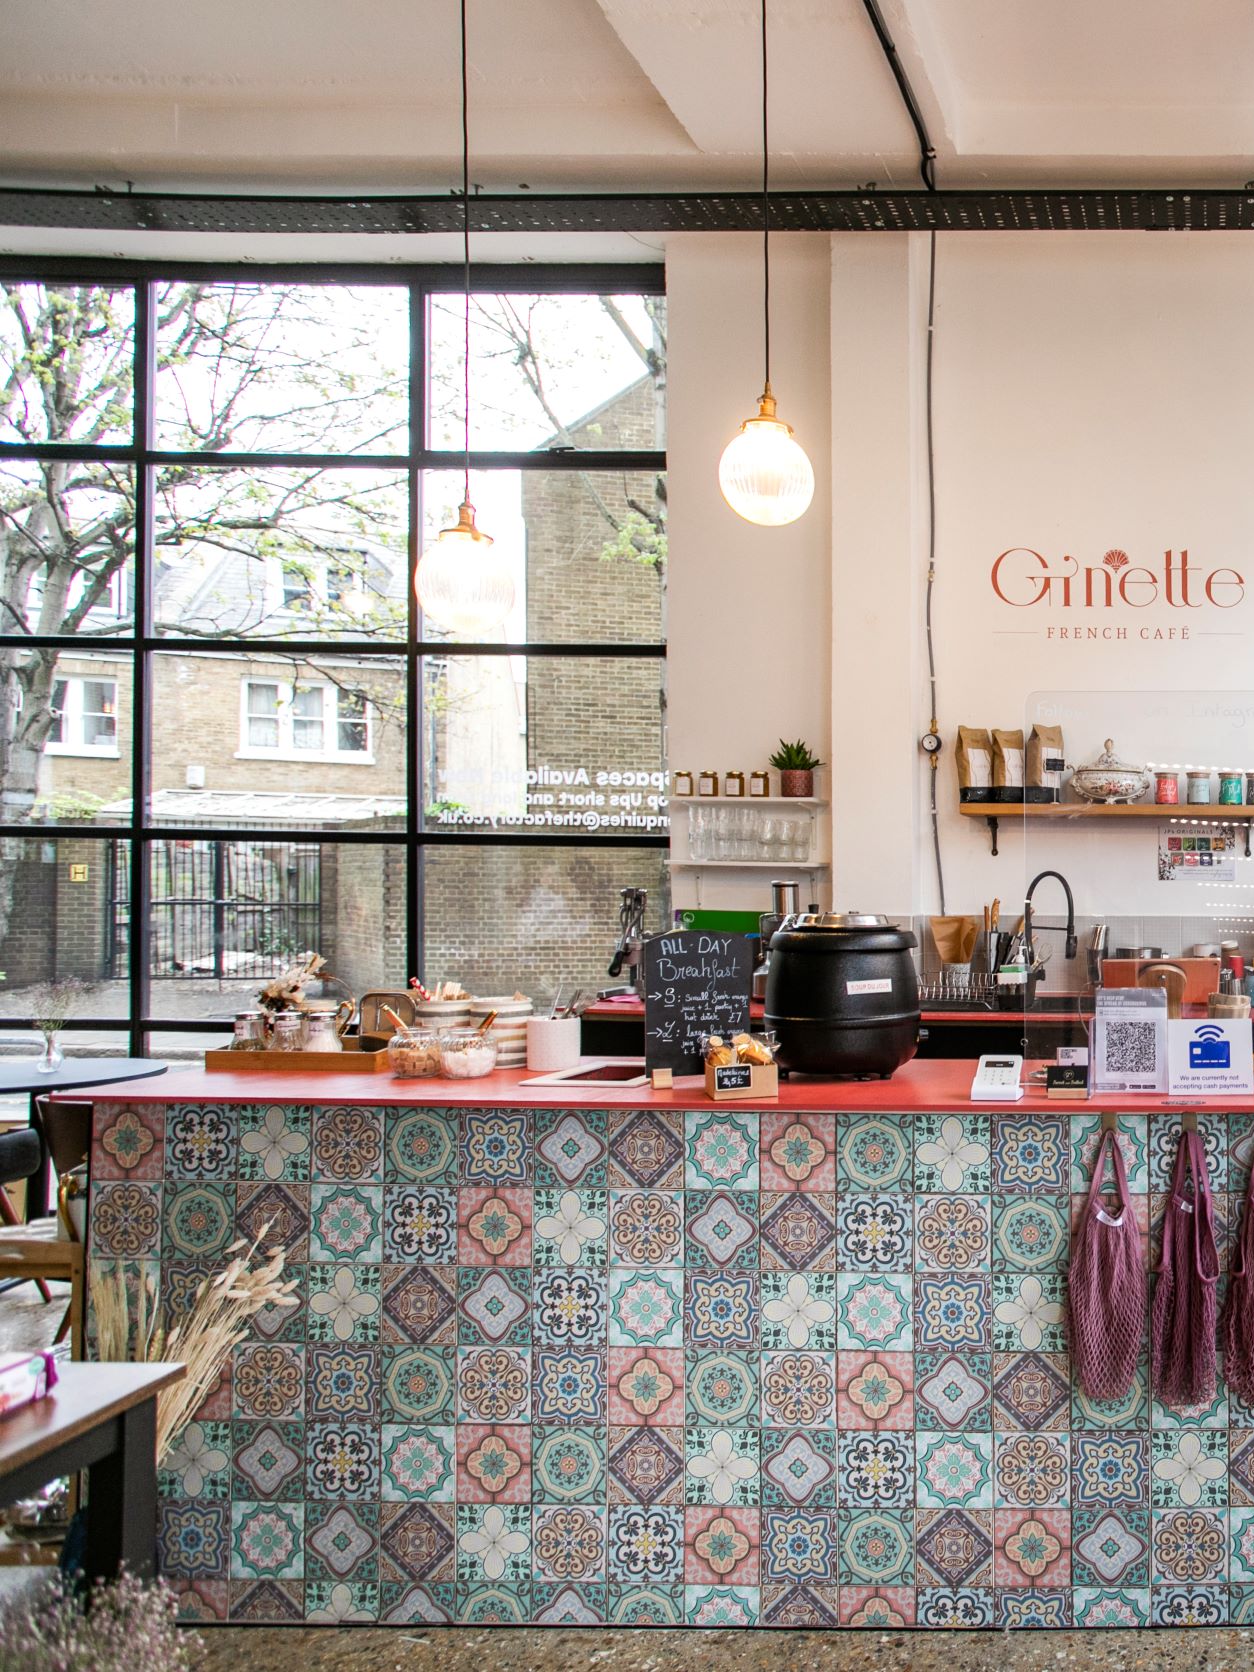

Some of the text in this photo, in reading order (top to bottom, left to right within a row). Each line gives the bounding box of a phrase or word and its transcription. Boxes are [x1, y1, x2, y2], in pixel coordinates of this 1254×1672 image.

[990, 547, 1245, 608] Ginette
[1047, 625, 1190, 640] FRENCH CAFÉ
[656, 957, 741, 992] Breakfast
